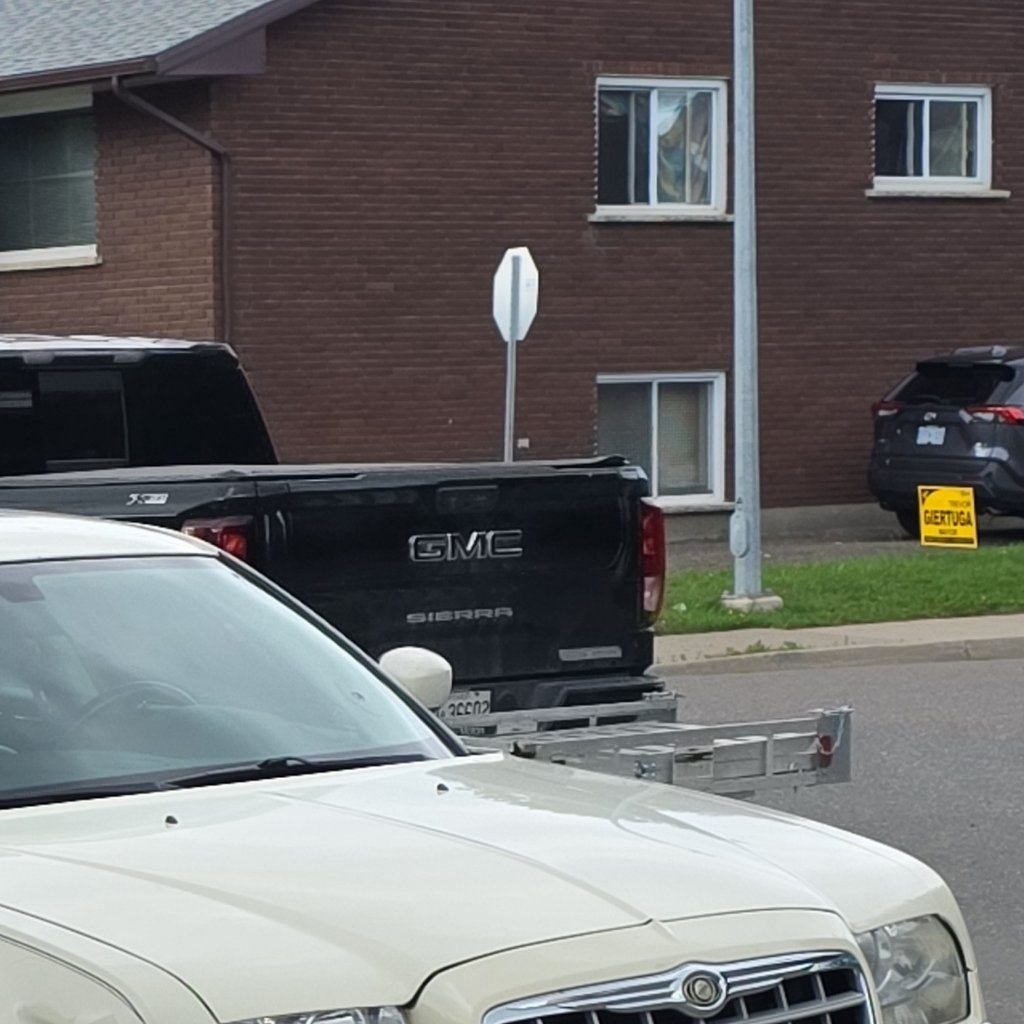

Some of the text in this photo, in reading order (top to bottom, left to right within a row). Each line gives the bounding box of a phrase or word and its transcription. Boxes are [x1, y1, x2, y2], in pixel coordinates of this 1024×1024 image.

[924, 509, 974, 527] GIERTUGA
[408, 529, 523, 562] GMC
[406, 606, 514, 624] SIERRA
